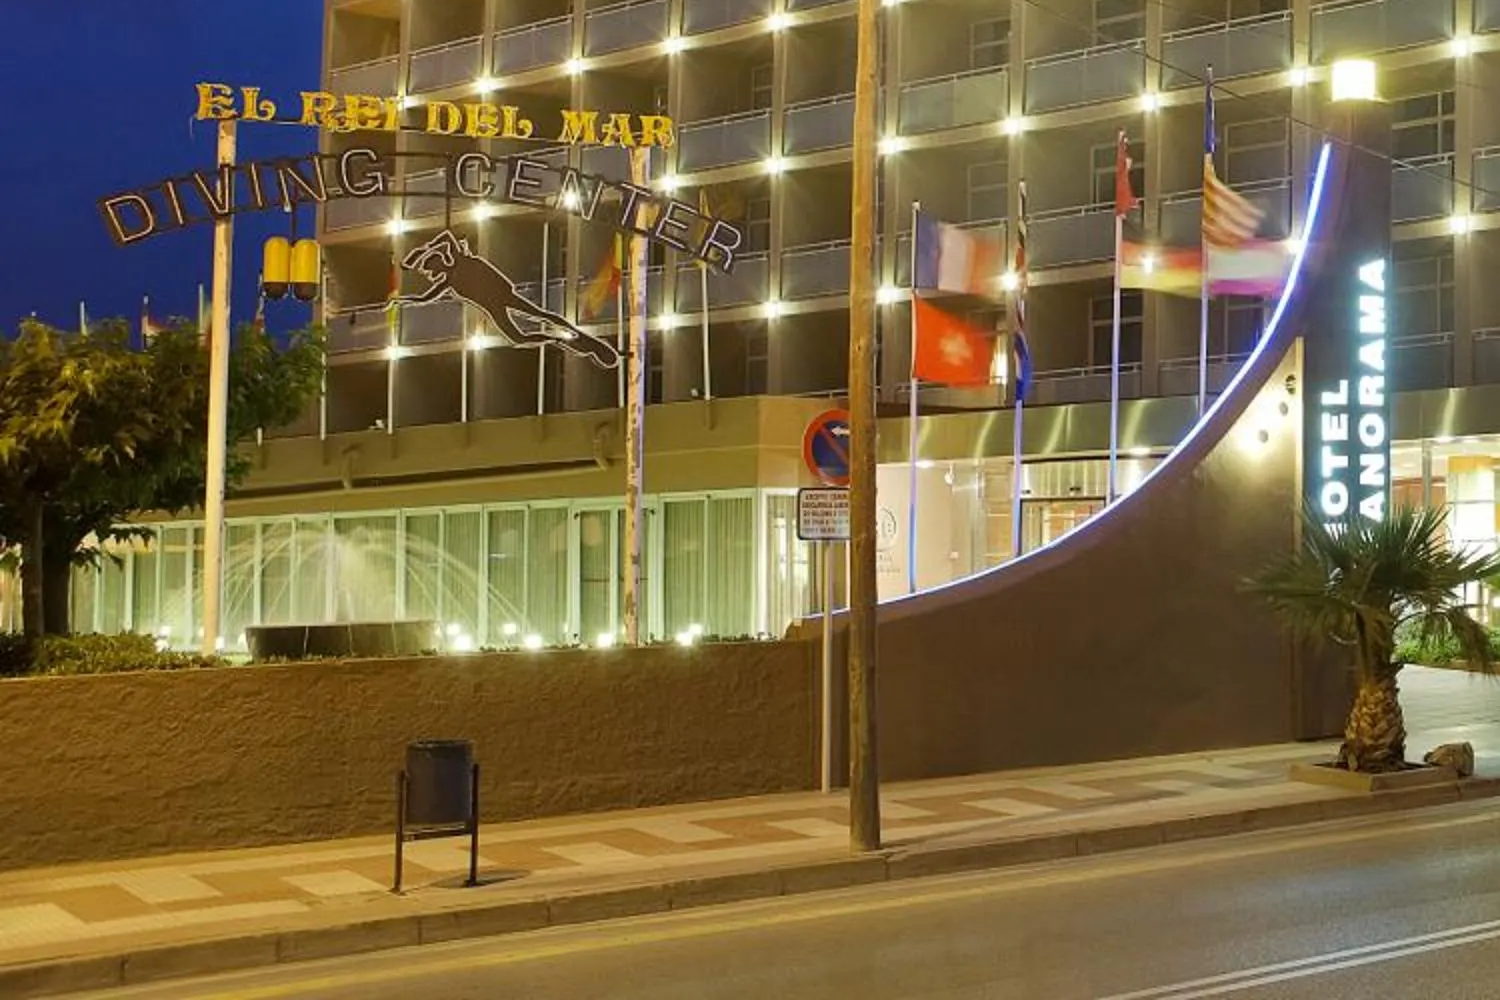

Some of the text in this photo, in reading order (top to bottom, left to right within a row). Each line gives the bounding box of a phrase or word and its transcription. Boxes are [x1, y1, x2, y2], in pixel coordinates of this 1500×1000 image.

[195, 81, 676, 148] EL REI DEL MAR
[102, 148, 745, 273] DIVING CENTER
[1358, 257, 1386, 545] ANORAMA
